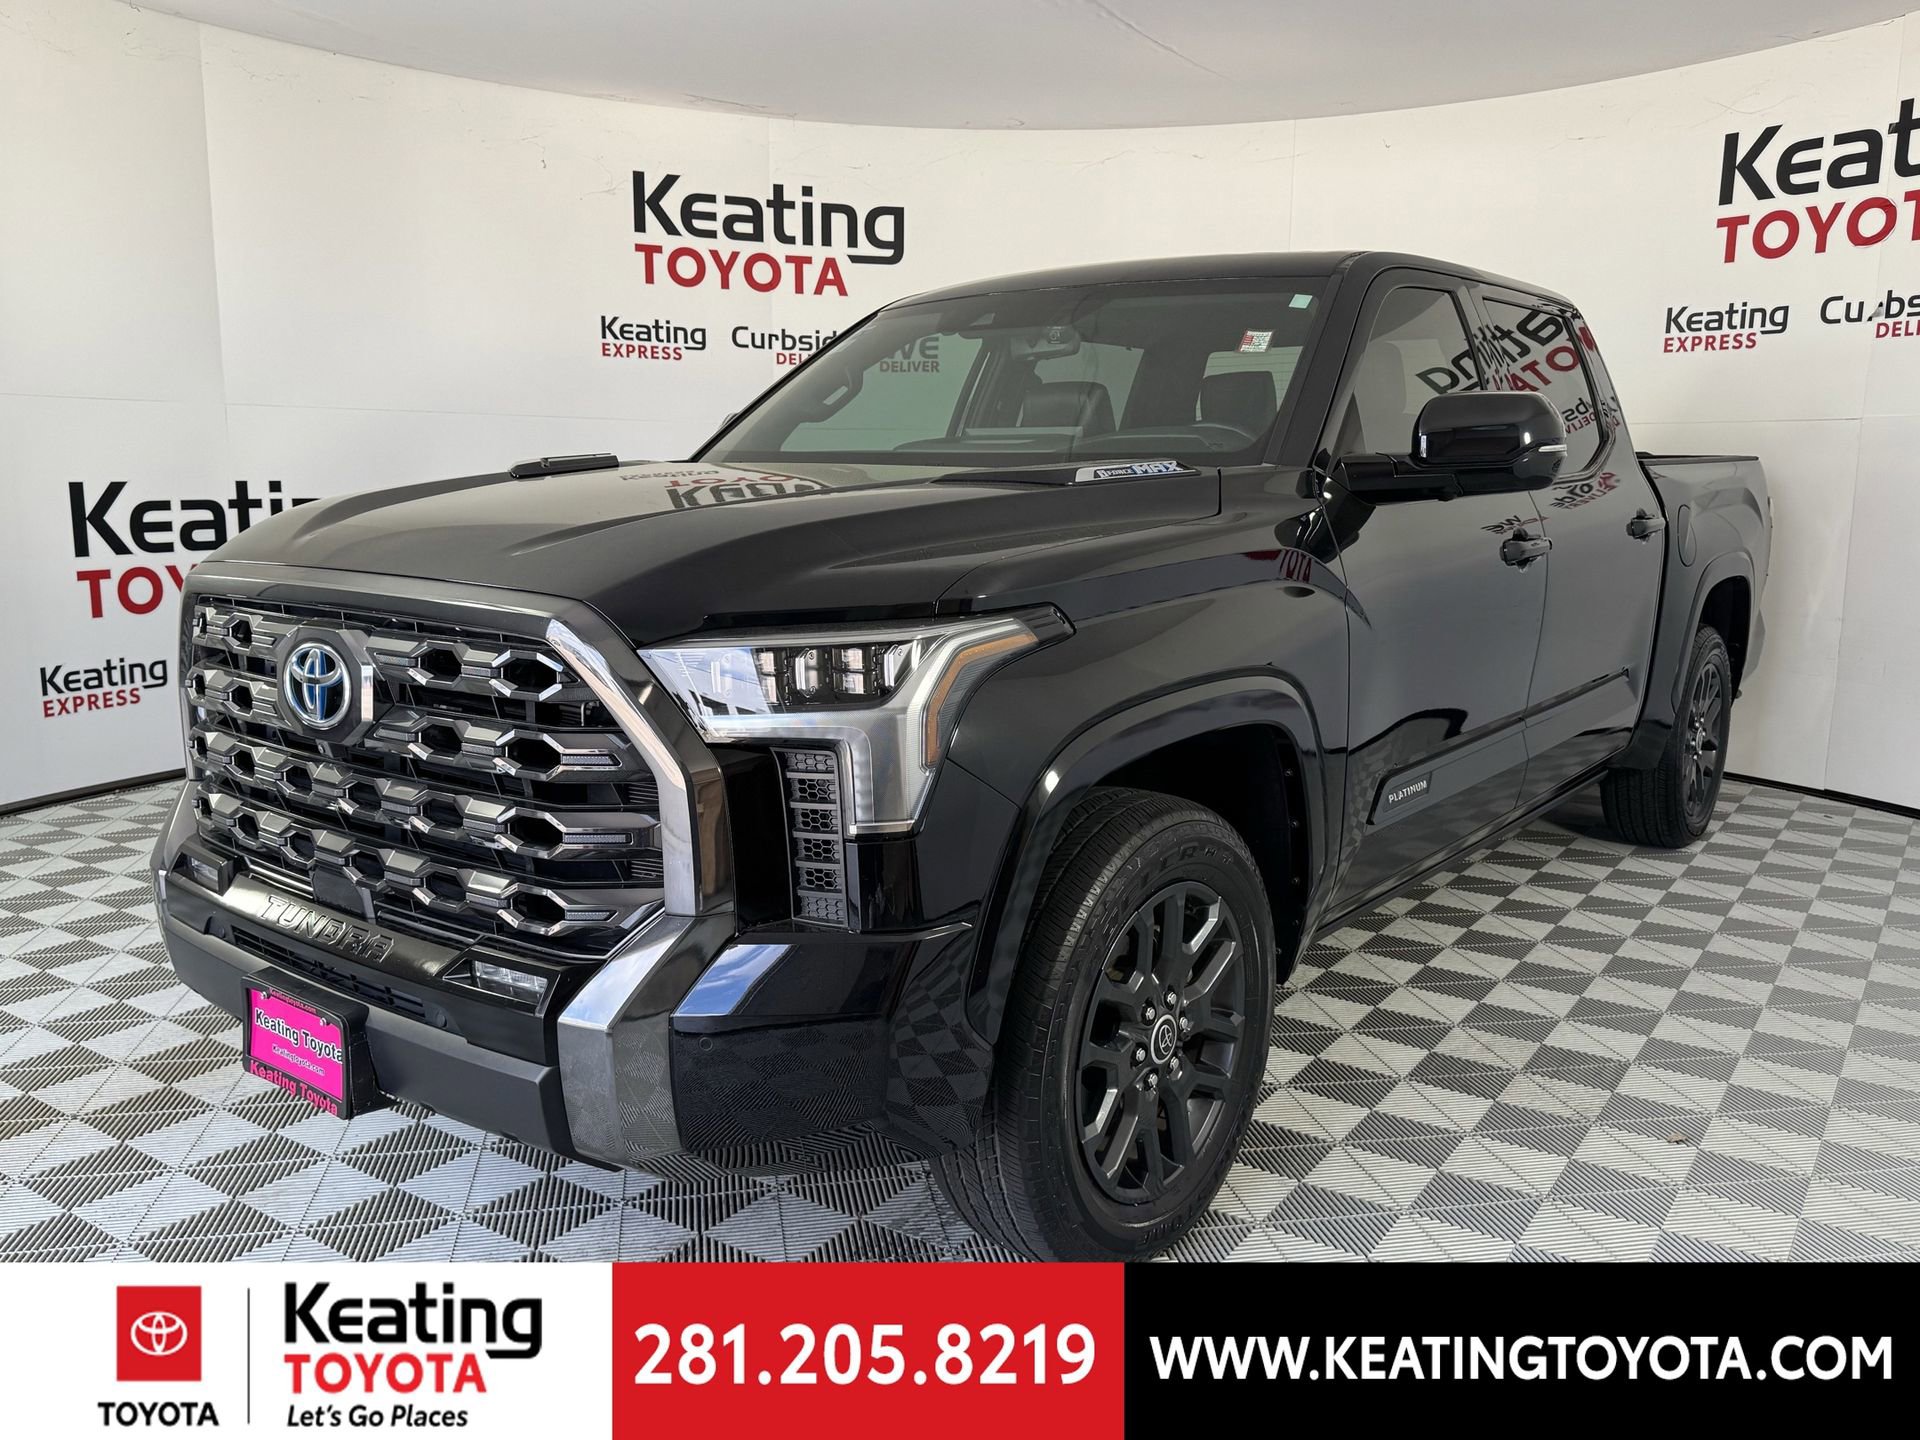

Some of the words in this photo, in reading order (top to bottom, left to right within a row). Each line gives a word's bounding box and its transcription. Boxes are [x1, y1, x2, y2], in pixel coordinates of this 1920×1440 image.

[632, 170, 905, 265] Keating
[634, 243, 849, 297] TOYOTA
[601, 315, 707, 350] Keating
[1665, 301, 1789, 334] Keating
[602, 343, 683, 361] EXPRESS
[1663, 332, 1757, 353] EXPRESS
[880, 361, 940, 373] DELIVER
[1132, 462, 1184, 475] MAX
[40, 658, 168, 696] Keating
[43, 688, 141, 718] EXPRESS
[1388, 780, 1428, 804] PLATINUM
[260, 895, 395, 963] TUNDRA
[255, 1008, 300, 1046] Keating
[302, 1030, 342, 1064] Toyota
[250, 1060, 297, 1097] Keating
[300, 1082, 338, 1115] Toyota
